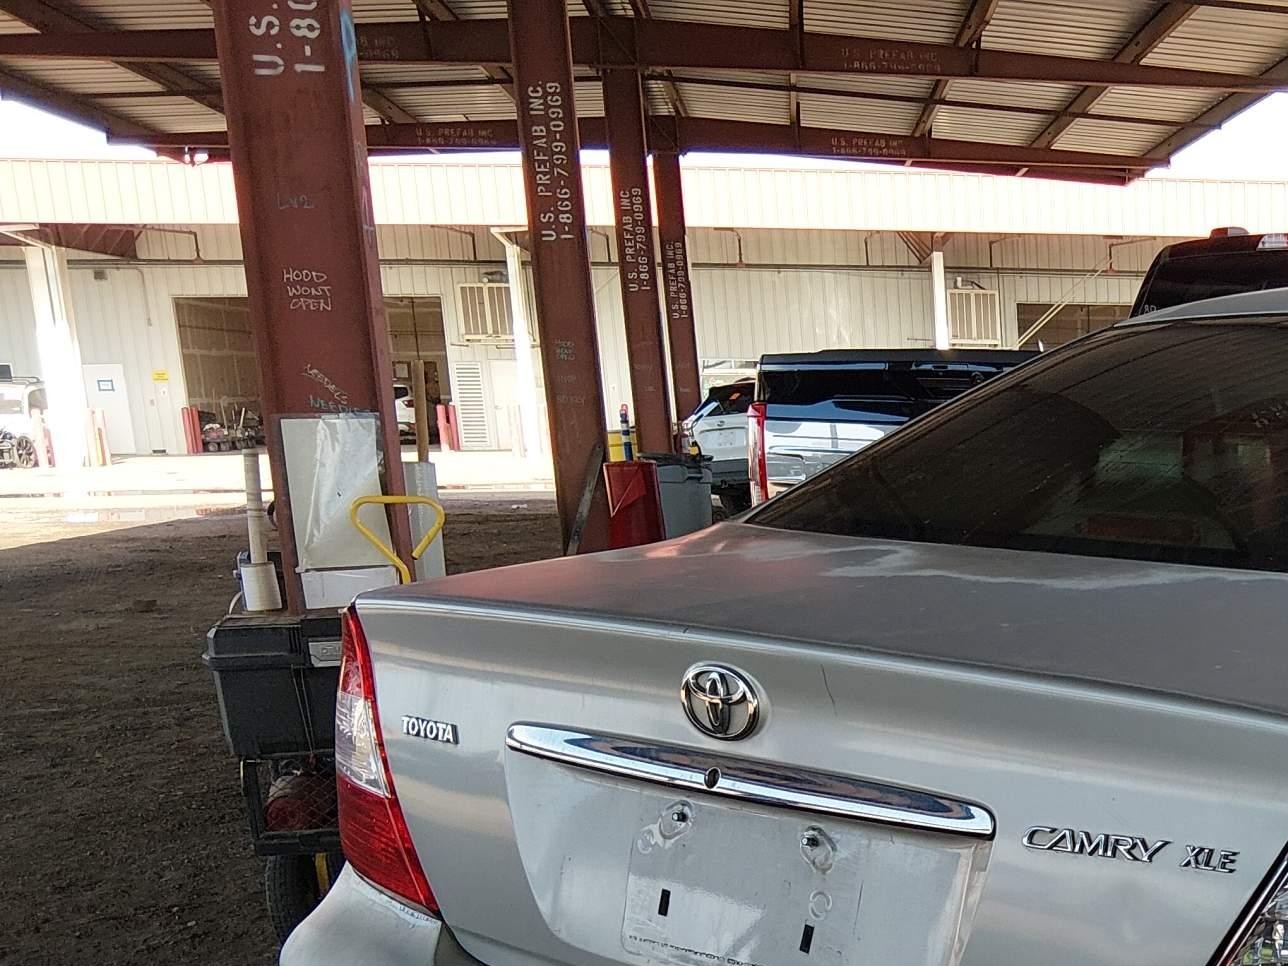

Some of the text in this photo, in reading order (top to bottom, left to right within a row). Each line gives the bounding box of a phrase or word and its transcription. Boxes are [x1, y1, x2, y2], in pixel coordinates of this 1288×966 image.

[527, 80, 558, 242] U.S. PREFAB INC.
[546, 82, 576, 240] 1-866-799-0969
[619, 190, 640, 292] U.S. PREFAB INC
[631, 187, 651, 291] 1-866-799-0969
[283, 266, 328, 283] HOOD
[287, 285, 332, 297] WONT
[667, 262, 678, 298] PREFAB
[675, 241, 689, 319] 1-866-799-0969
[290, 298, 332, 311] OPEN
[671, 301, 681, 319] U.S.
[401, 716, 458, 744] TOYOTA
[1022, 825, 1240, 873] CAMRY XLE
